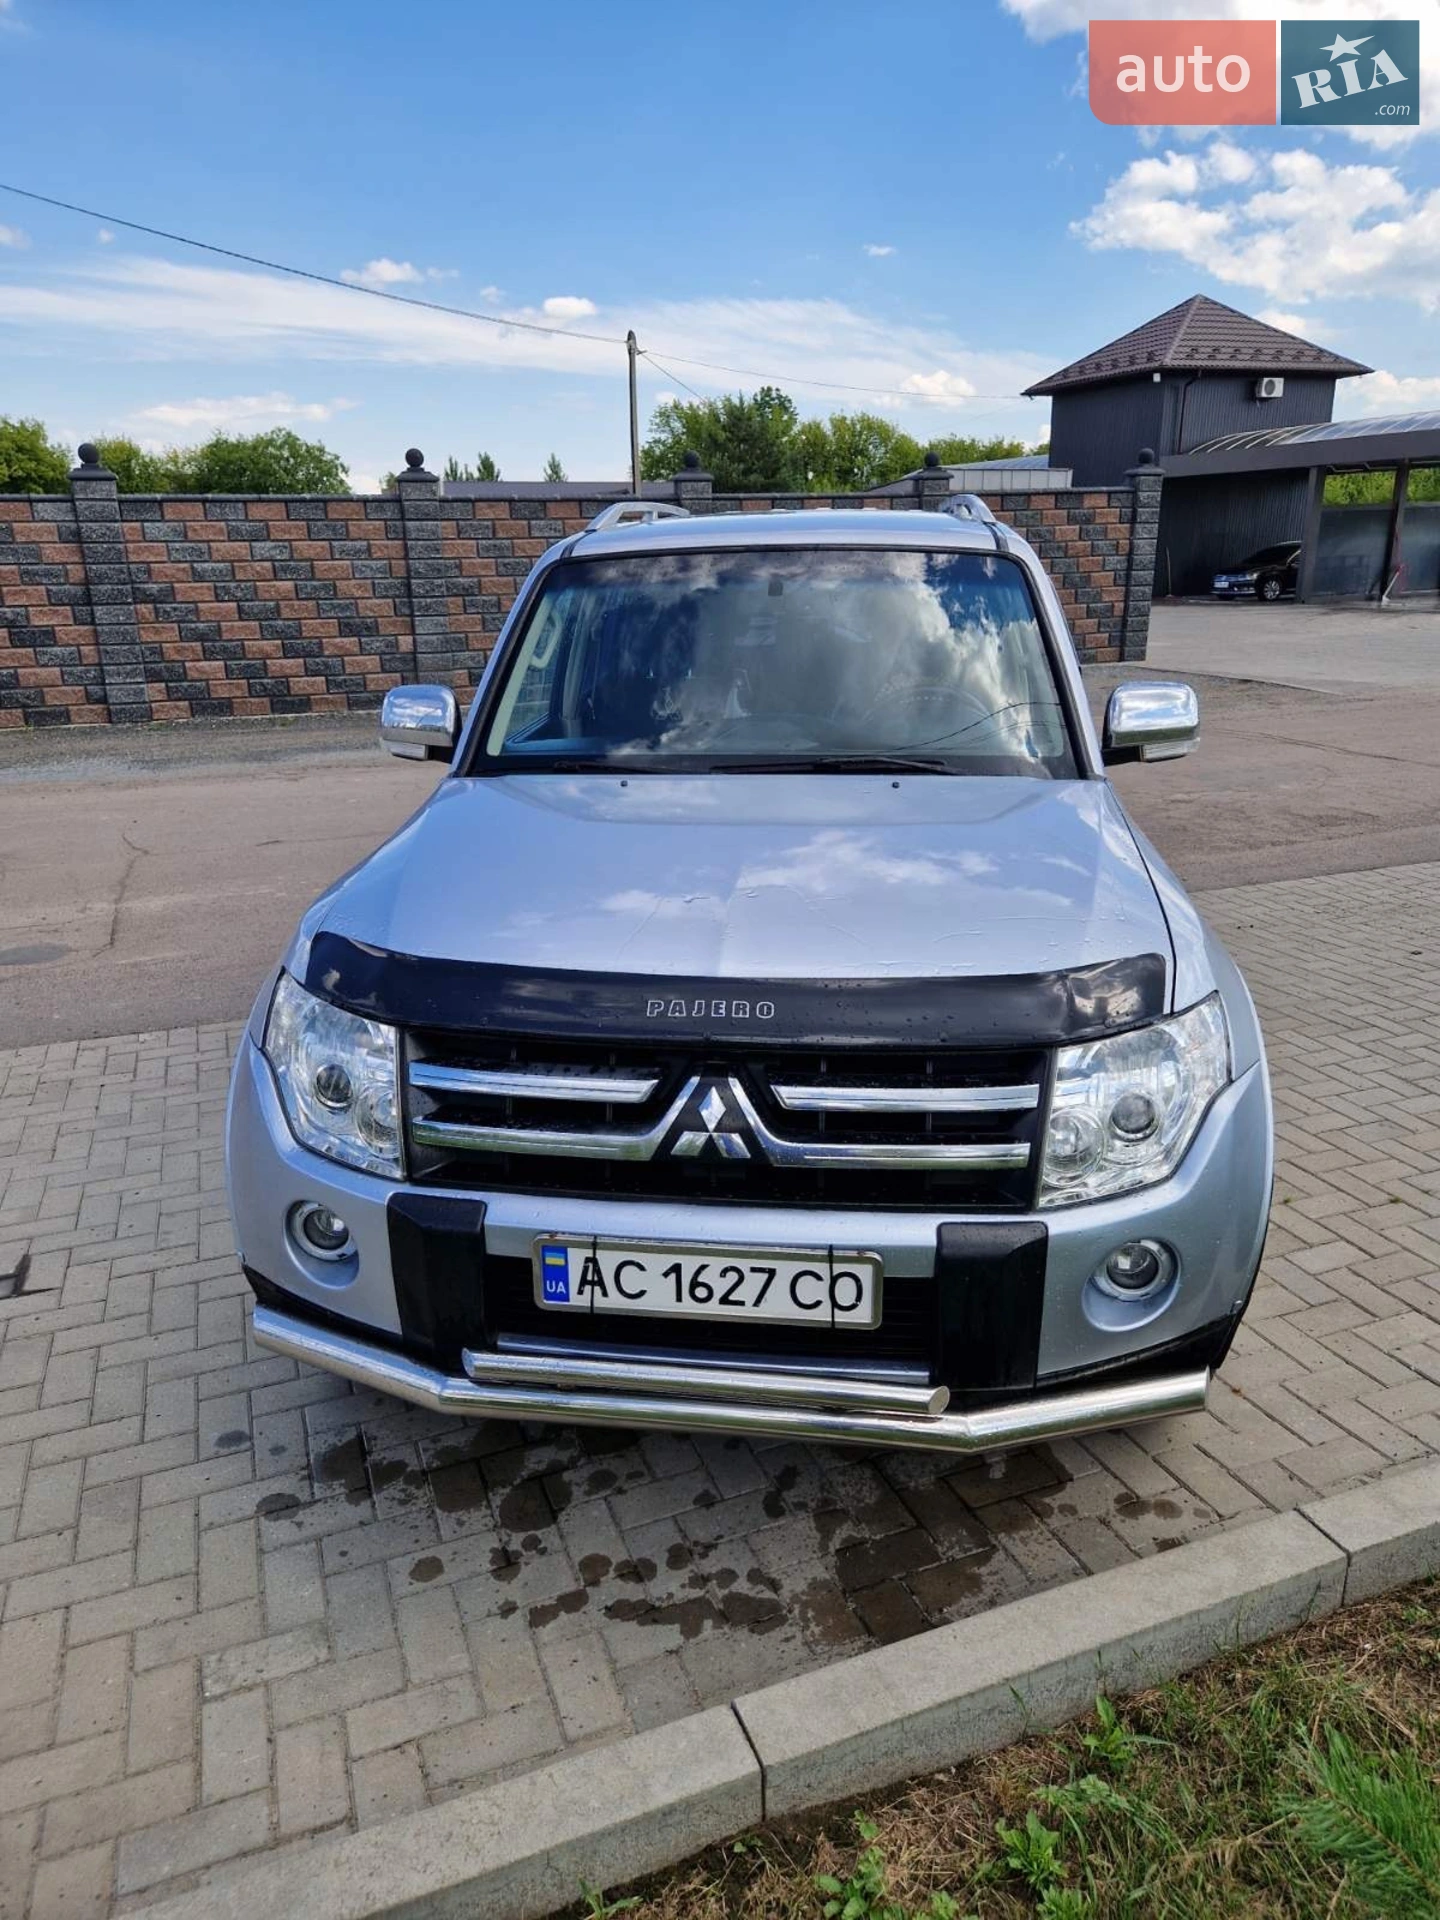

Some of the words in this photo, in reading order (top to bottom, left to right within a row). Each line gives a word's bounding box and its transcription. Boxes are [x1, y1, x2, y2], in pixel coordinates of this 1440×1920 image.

[646, 1000, 775, 1019] PAJERO
[546, 1279, 567, 1295] UA
[576, 1256, 648, 1300] AC
[661, 1262, 777, 1308] 1627
[789, 1269, 864, 1312] CO
